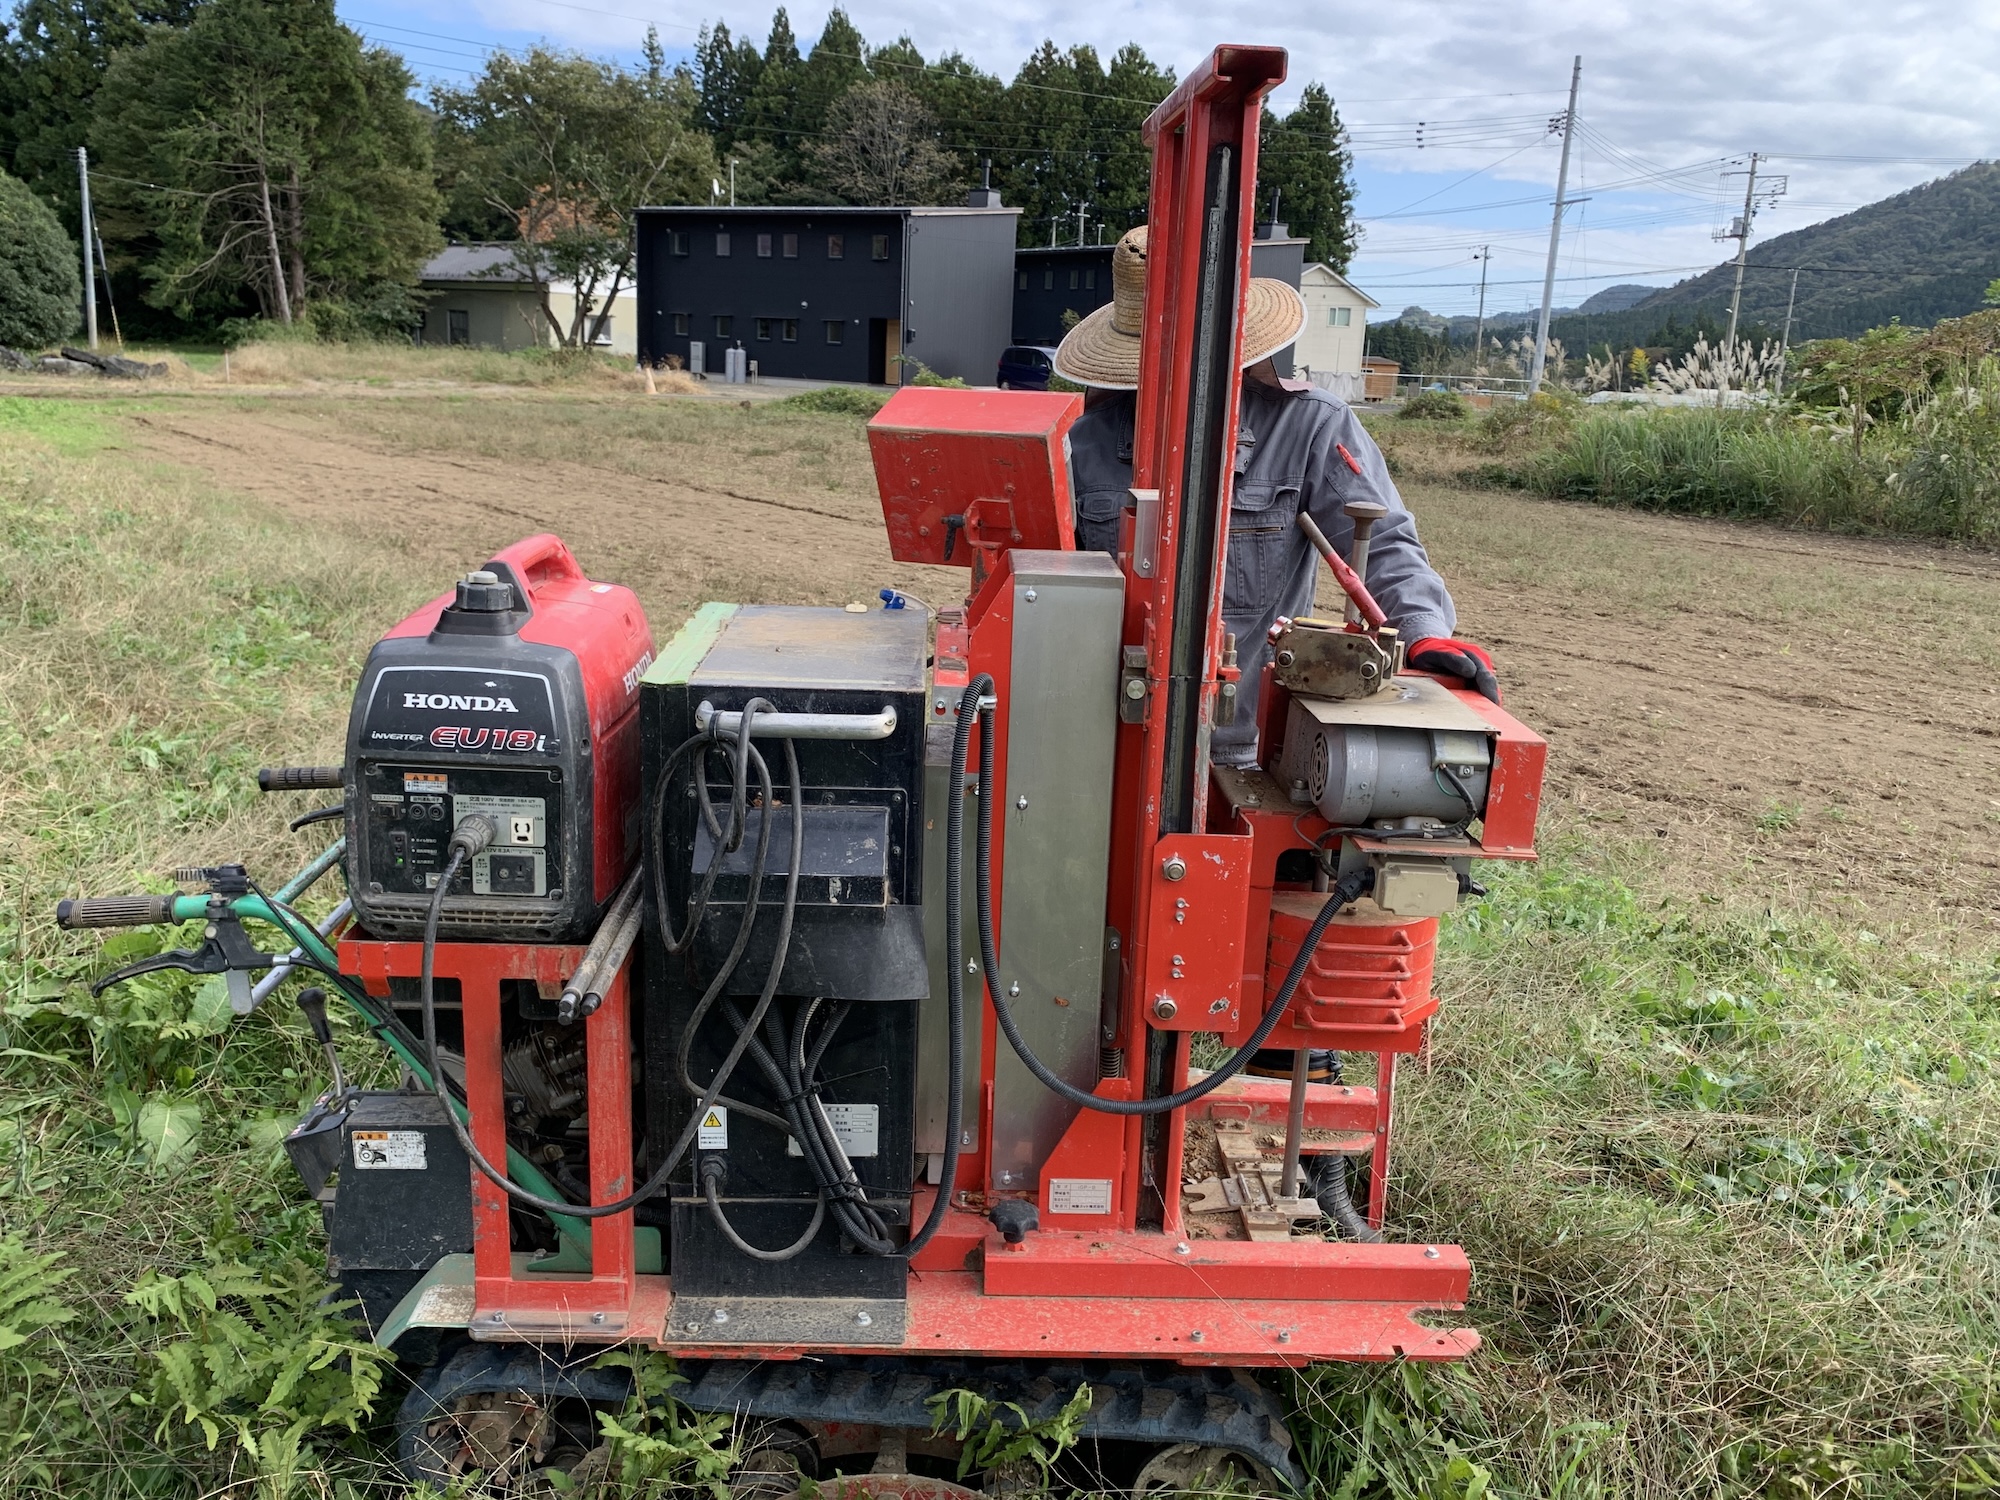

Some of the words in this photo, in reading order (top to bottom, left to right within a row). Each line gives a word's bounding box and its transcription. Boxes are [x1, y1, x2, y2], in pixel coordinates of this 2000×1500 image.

[622, 650, 653, 696] HONDA
[403, 693, 519, 713] HONDA
[430, 726, 546, 752] EU18i
